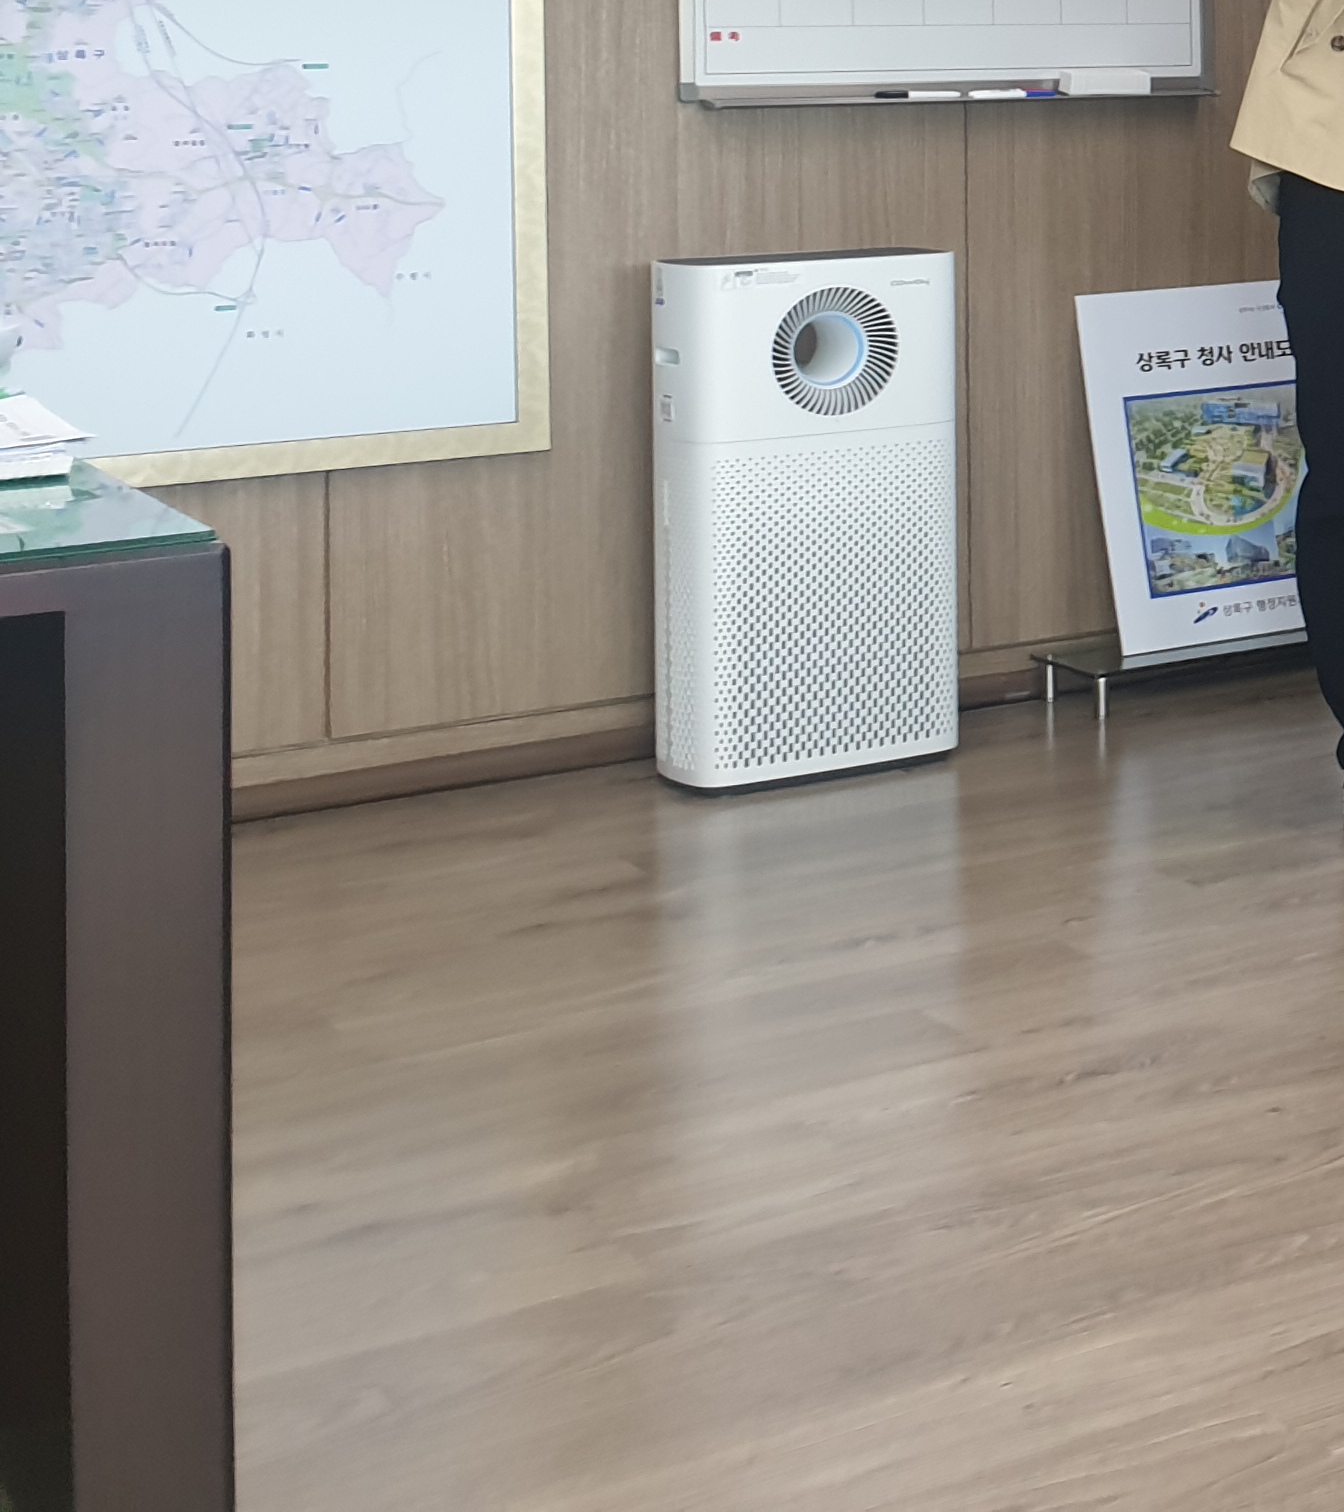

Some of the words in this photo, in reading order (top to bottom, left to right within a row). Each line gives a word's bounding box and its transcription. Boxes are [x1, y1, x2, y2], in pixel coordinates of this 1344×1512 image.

[1136, 349, 1191, 372] 상록구
[1197, 345, 1233, 366] 청사
[1239, 340, 1294, 362] 안내도
